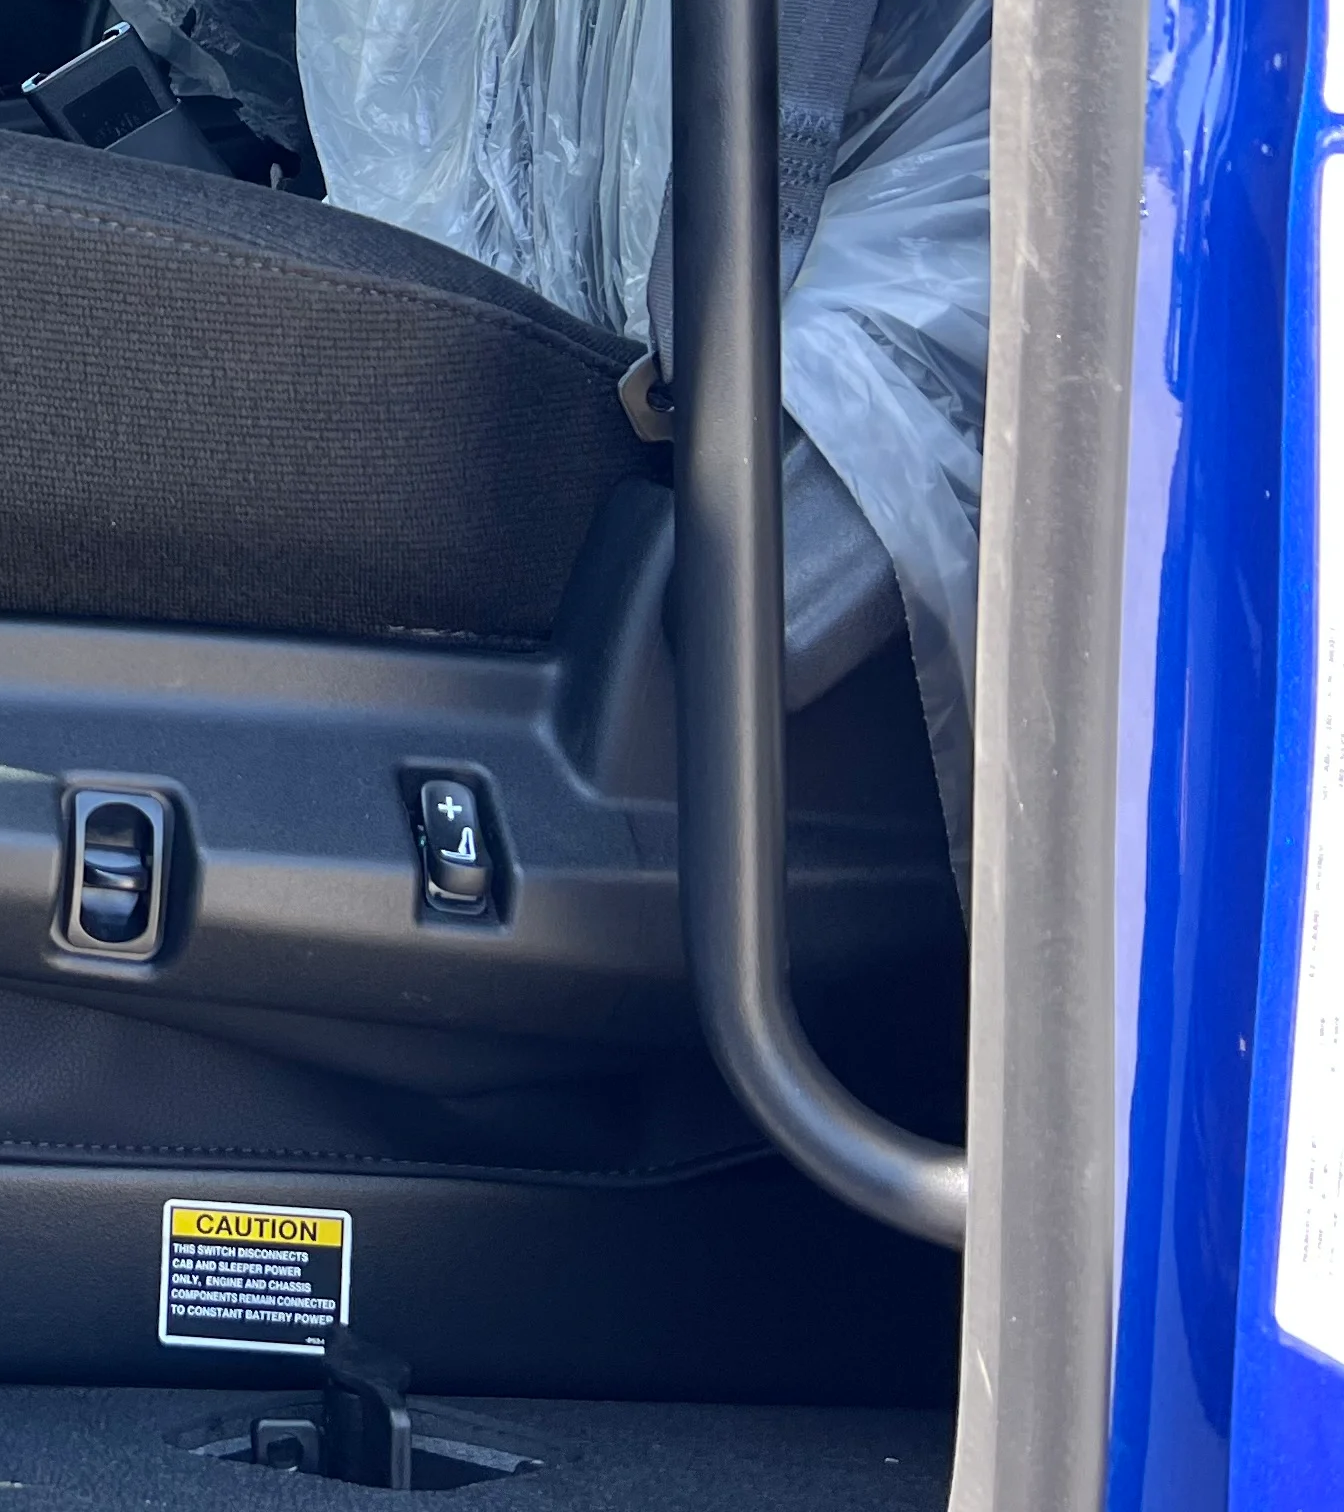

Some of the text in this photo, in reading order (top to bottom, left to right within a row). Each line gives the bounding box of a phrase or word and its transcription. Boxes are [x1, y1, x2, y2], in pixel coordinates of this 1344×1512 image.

[195, 1213, 318, 1242] CAUTION
[173, 1242, 310, 1263] THIS SWITCH DISCONNECTS
[172, 1257, 302, 1277] CAB AND SLEEPER POWER
[205, 1275, 244, 1289] ENGINE
[244, 1278, 267, 1291] AND
[268, 1279, 312, 1294] CHASSIS
[171, 1288, 337, 1311] COMPONENTS REMAIN CONNECTED
[170, 1303, 334, 1326] TO CONSTANT BATTERY POWER
